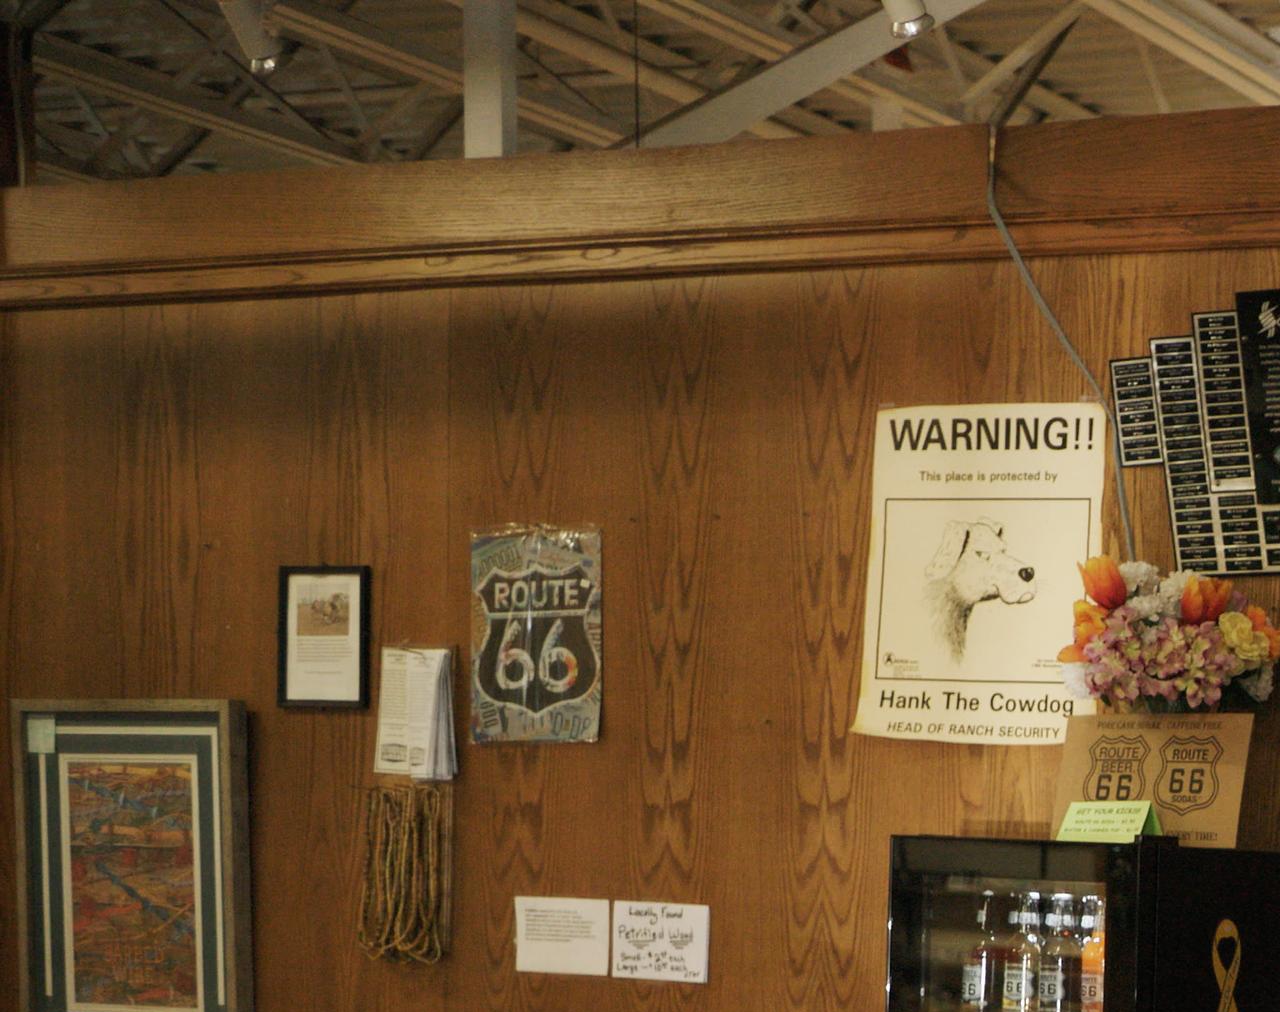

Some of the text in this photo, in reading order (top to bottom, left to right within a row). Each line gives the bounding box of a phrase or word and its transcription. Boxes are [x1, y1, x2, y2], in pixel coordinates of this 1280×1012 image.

[890, 417, 1094, 451] WARNING!!
[919, 470, 1058, 483] This place is protected by
[494, 579, 579, 608] ROUTE
[496, 618, 579, 693] 66
[879, 690, 1074, 718] Hank The Cowdog
[887, 722, 1060, 739] HEAD OF RANCH SECURITY
[1099, 747, 1140, 759] ROUTE
[1172, 749, 1209, 761] ROUTE
[1101, 762, 1135, 773] BEER
[1096, 774, 1132, 800] 66
[1169, 768, 1205, 794] 66
